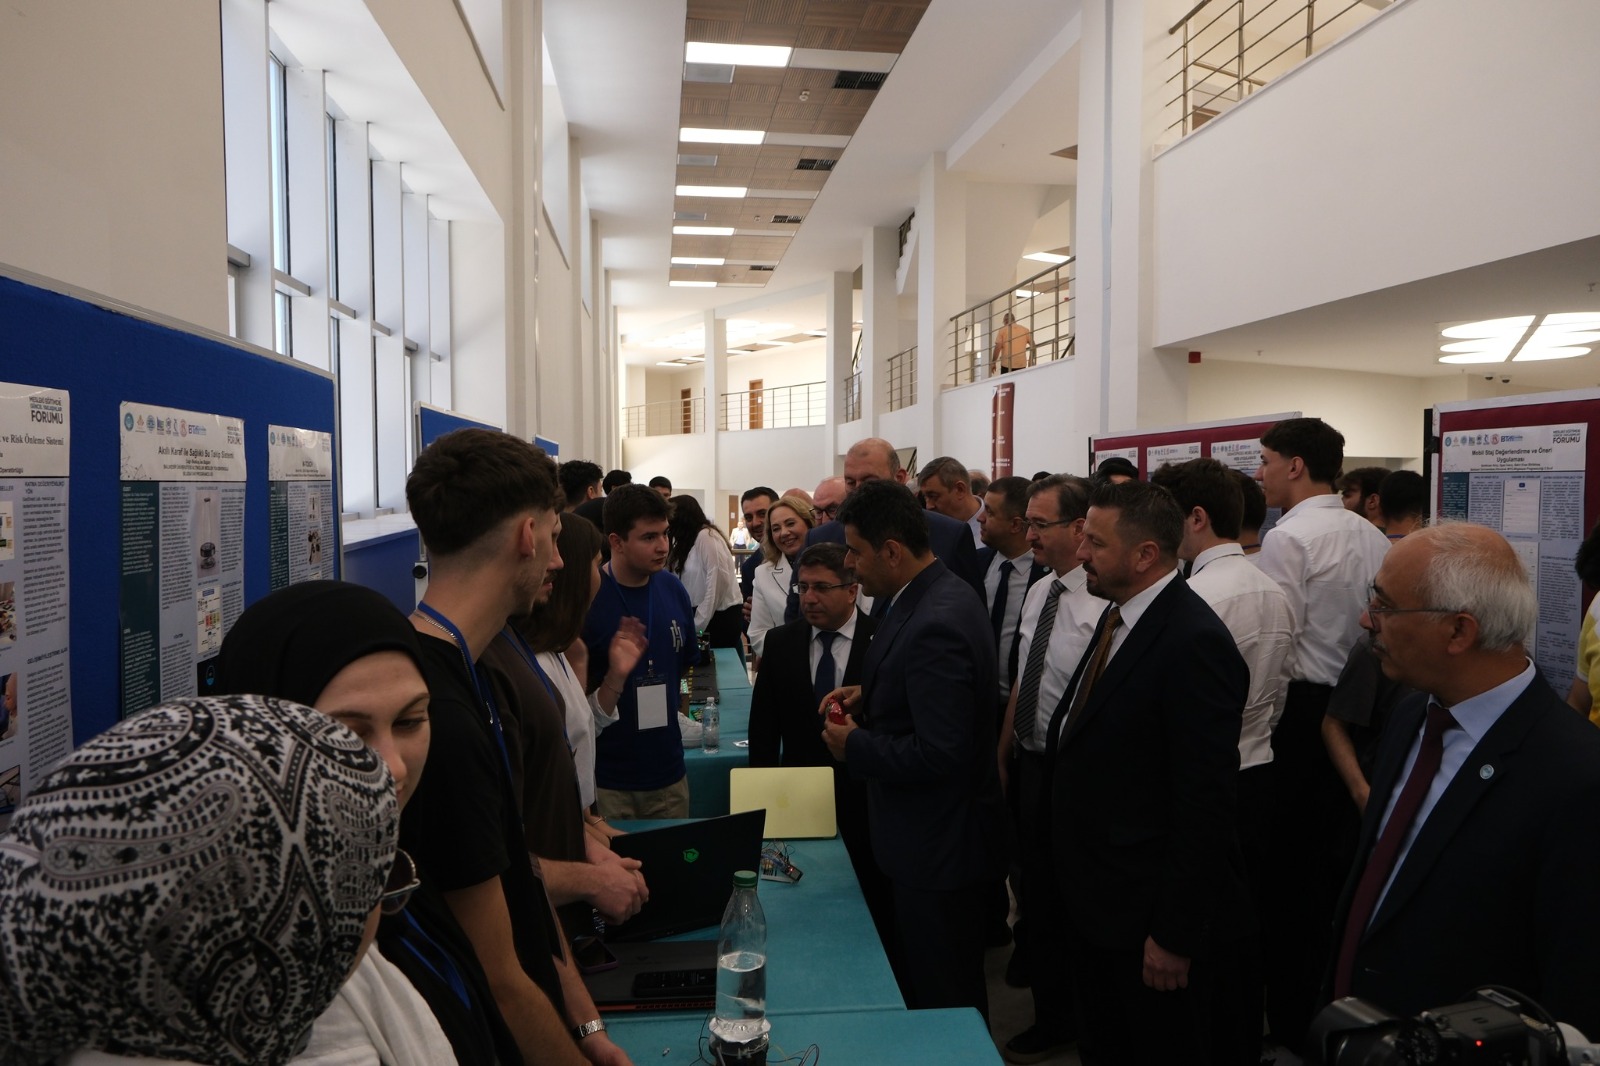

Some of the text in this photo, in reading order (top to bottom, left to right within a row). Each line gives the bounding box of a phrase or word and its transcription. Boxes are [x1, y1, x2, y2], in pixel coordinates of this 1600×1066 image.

[31, 410, 64, 424] FORUMU
[10, 434, 24, 444] Risk
[24, 433, 45, 445] Önleme
[46, 436, 64, 446] Sistemi
